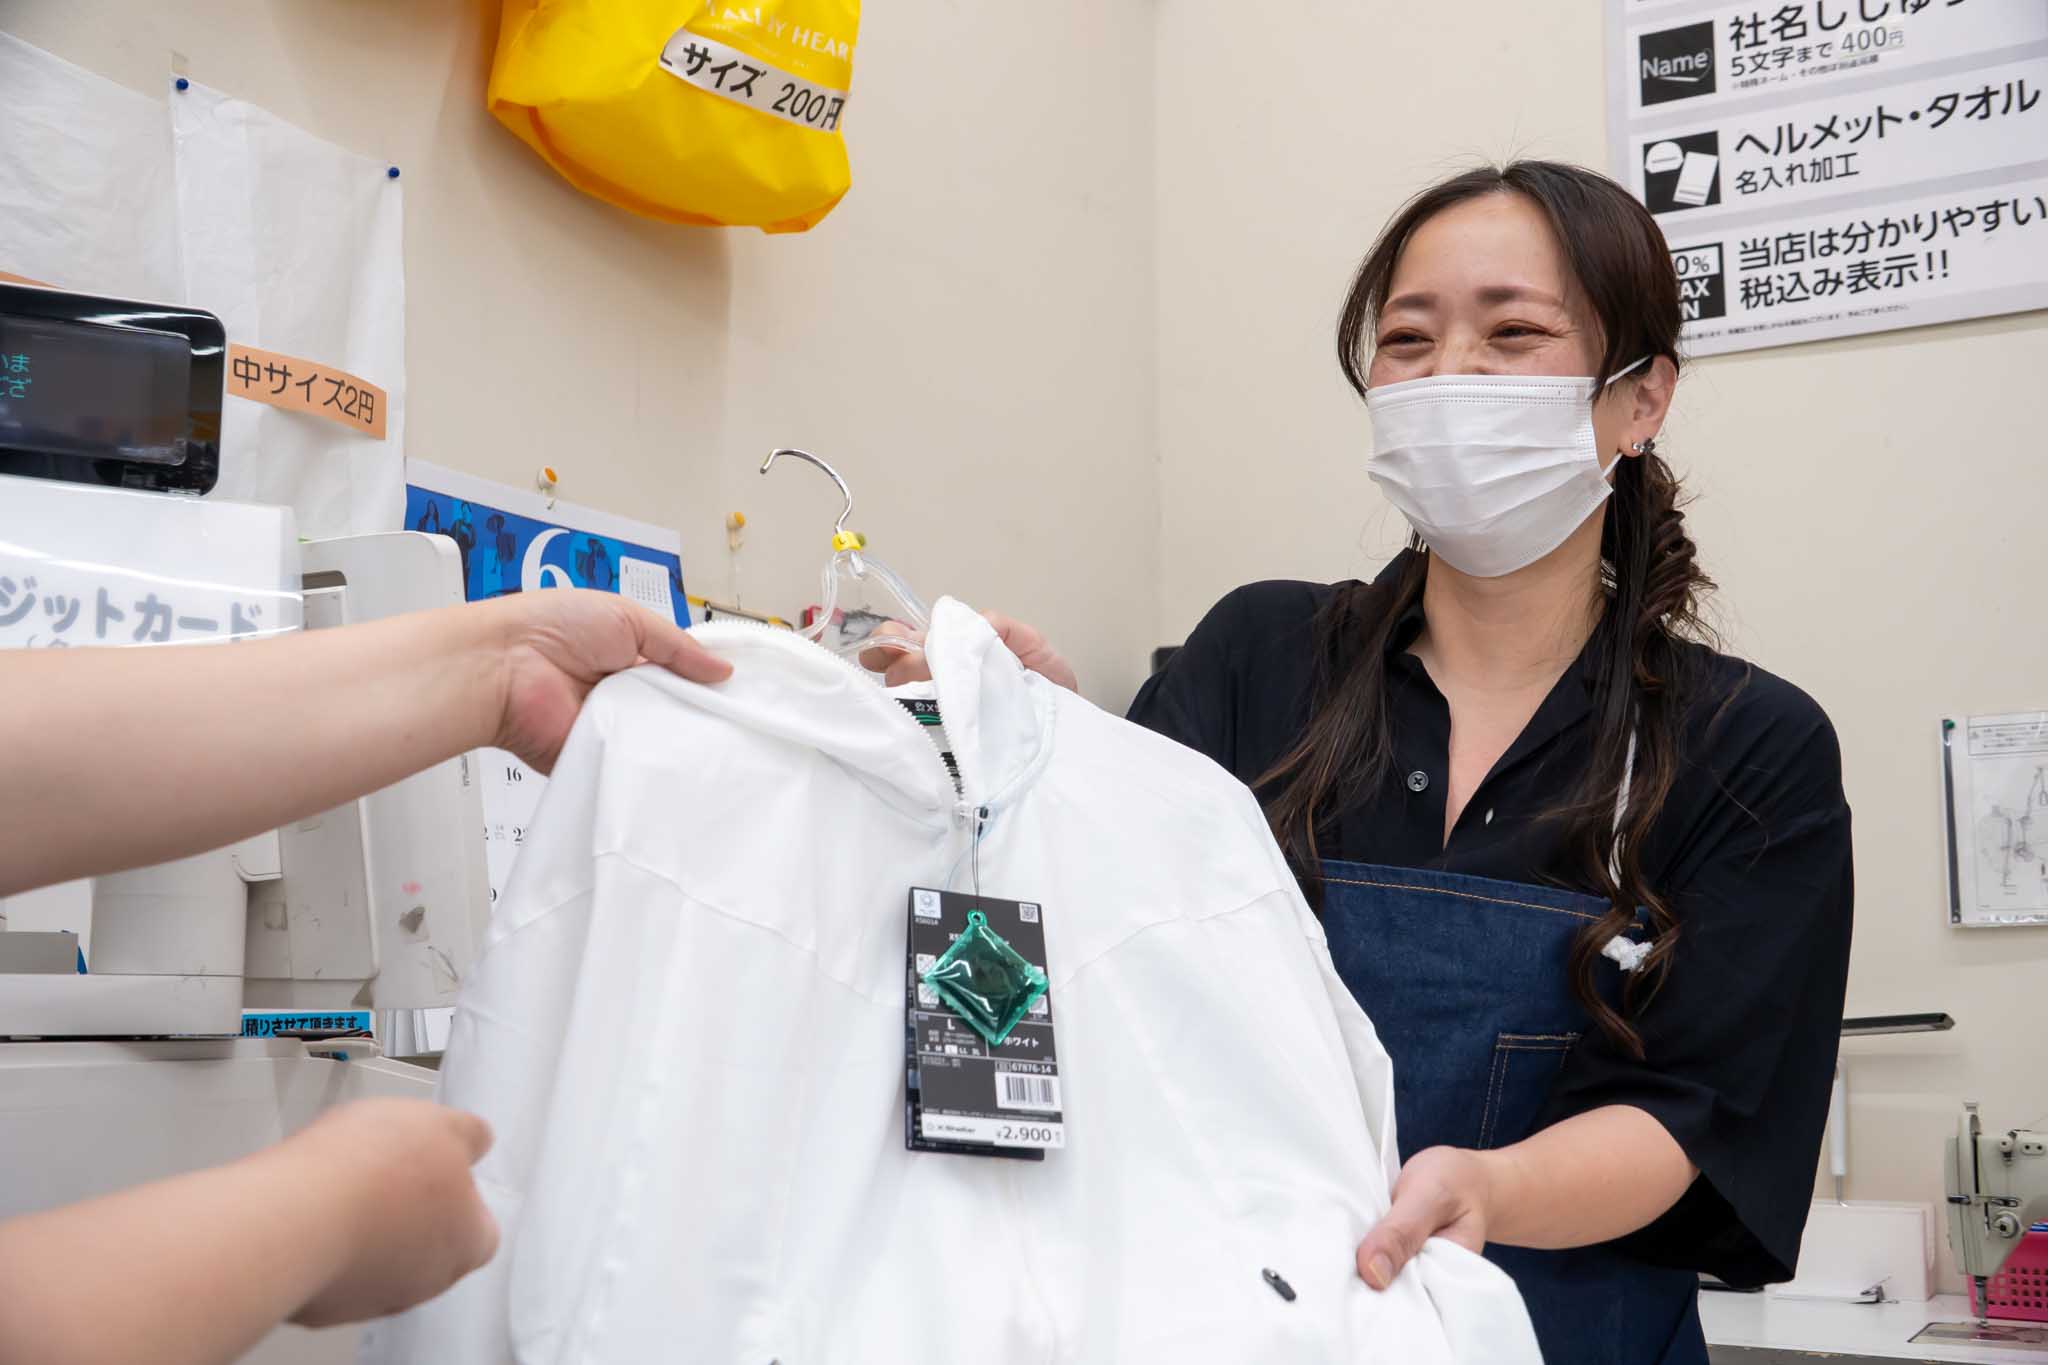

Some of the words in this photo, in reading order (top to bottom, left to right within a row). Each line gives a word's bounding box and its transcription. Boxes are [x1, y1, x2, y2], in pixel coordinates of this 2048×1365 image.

[1728, 0, 1964, 51] 社名ししゅ
[1642, 51, 1709, 80] Name
[1731, 42, 1833, 77] 5文字まで
[1841, 26, 1904, 52] 400円
[771, 82, 846, 130] 200円
[1734, 79, 2041, 158] ヘルメット・タオル
[1735, 152, 1860, 196] 名入れ加工
[1738, 196, 2047, 272] 当店は分かりやすい
[1675, 255, 1711, 276] 0%
[1739, 249, 1950, 311] 税込み表示!!
[1679, 278, 1711, 300] AX
[233, 355, 375, 424] 中サイズ2円
[506, 767, 522, 782] 16
[241, 1016, 363, 1037] 積りさせて頂きます。
[947, 1018, 956, 1030] L
[1004, 1036, 1040, 1049] ホワイト
